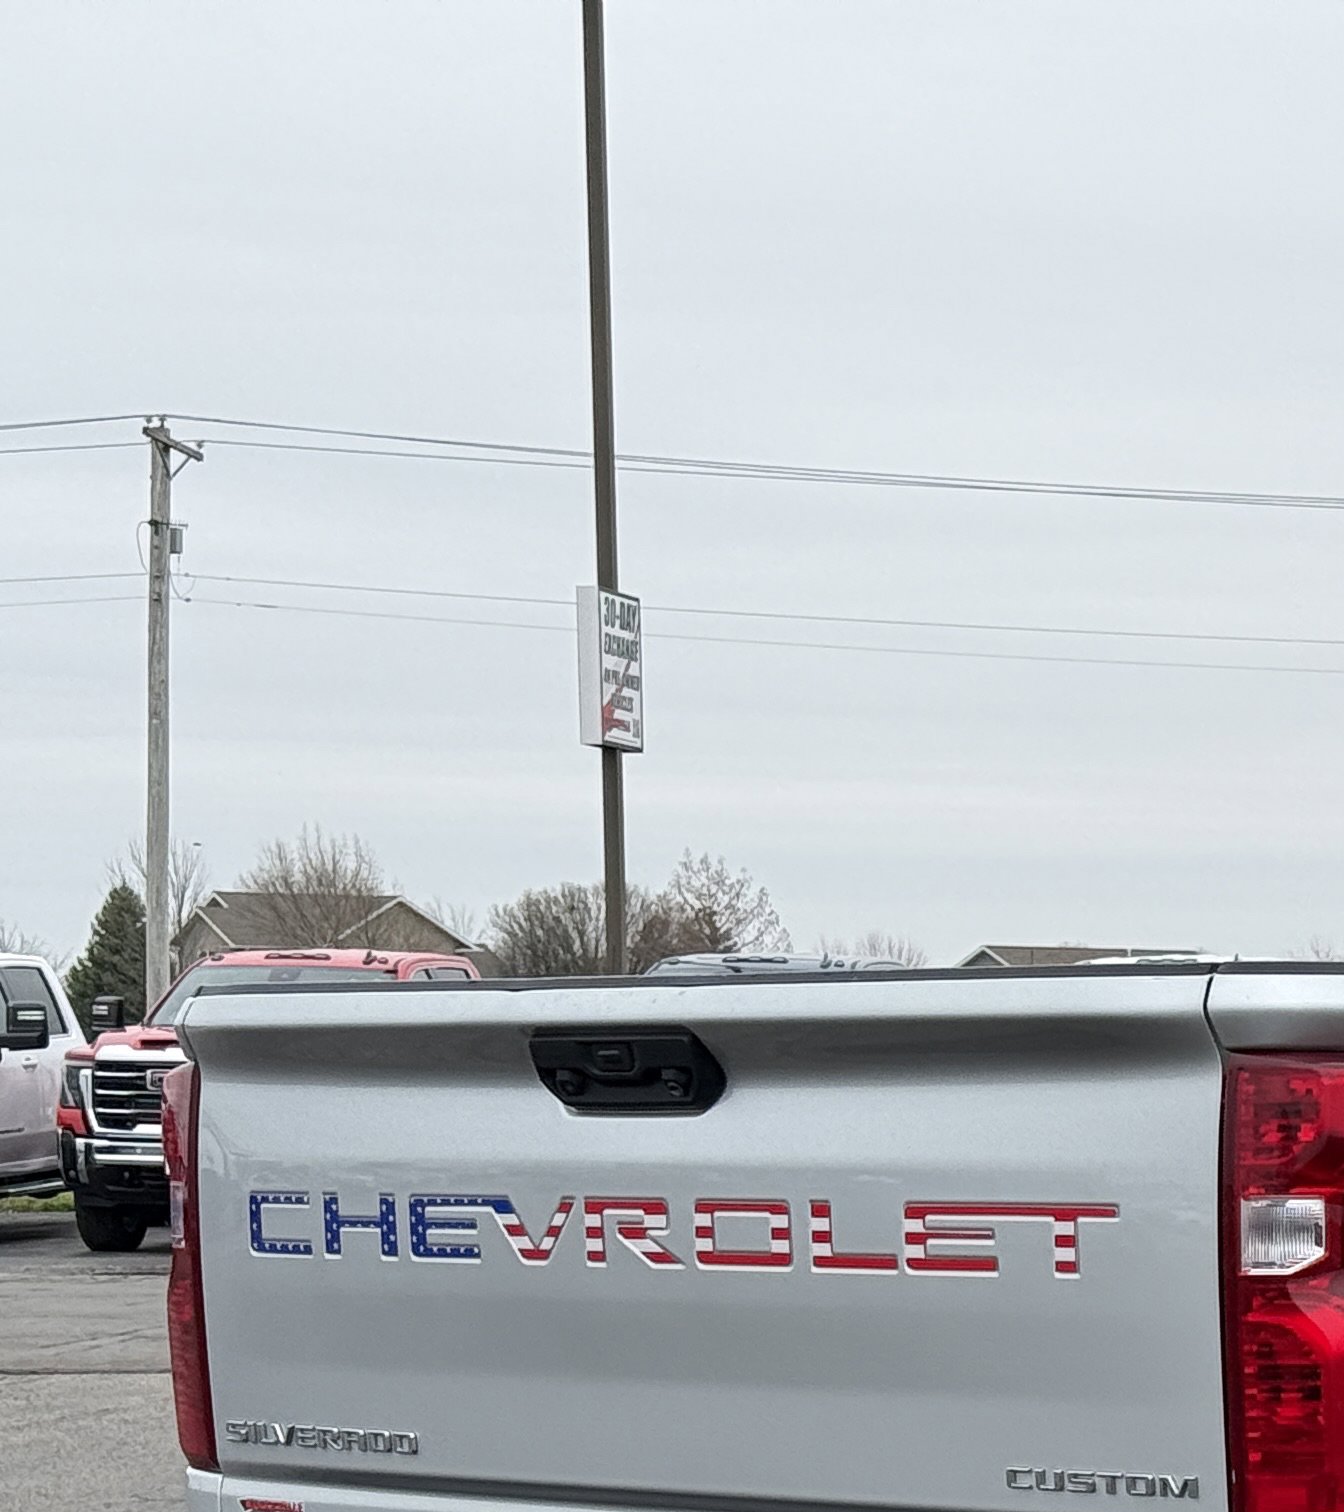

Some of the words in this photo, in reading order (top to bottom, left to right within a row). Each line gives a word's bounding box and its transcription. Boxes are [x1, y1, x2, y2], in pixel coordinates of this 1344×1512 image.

[604, 596, 637, 633] 30-DAY
[604, 632, 639, 662] EXCHANGE
[248, 1190, 1121, 1279] CHEVROLET
[226, 1419, 418, 1454] SILVERADO
[1006, 1465, 1199, 1500] CUSTOM
